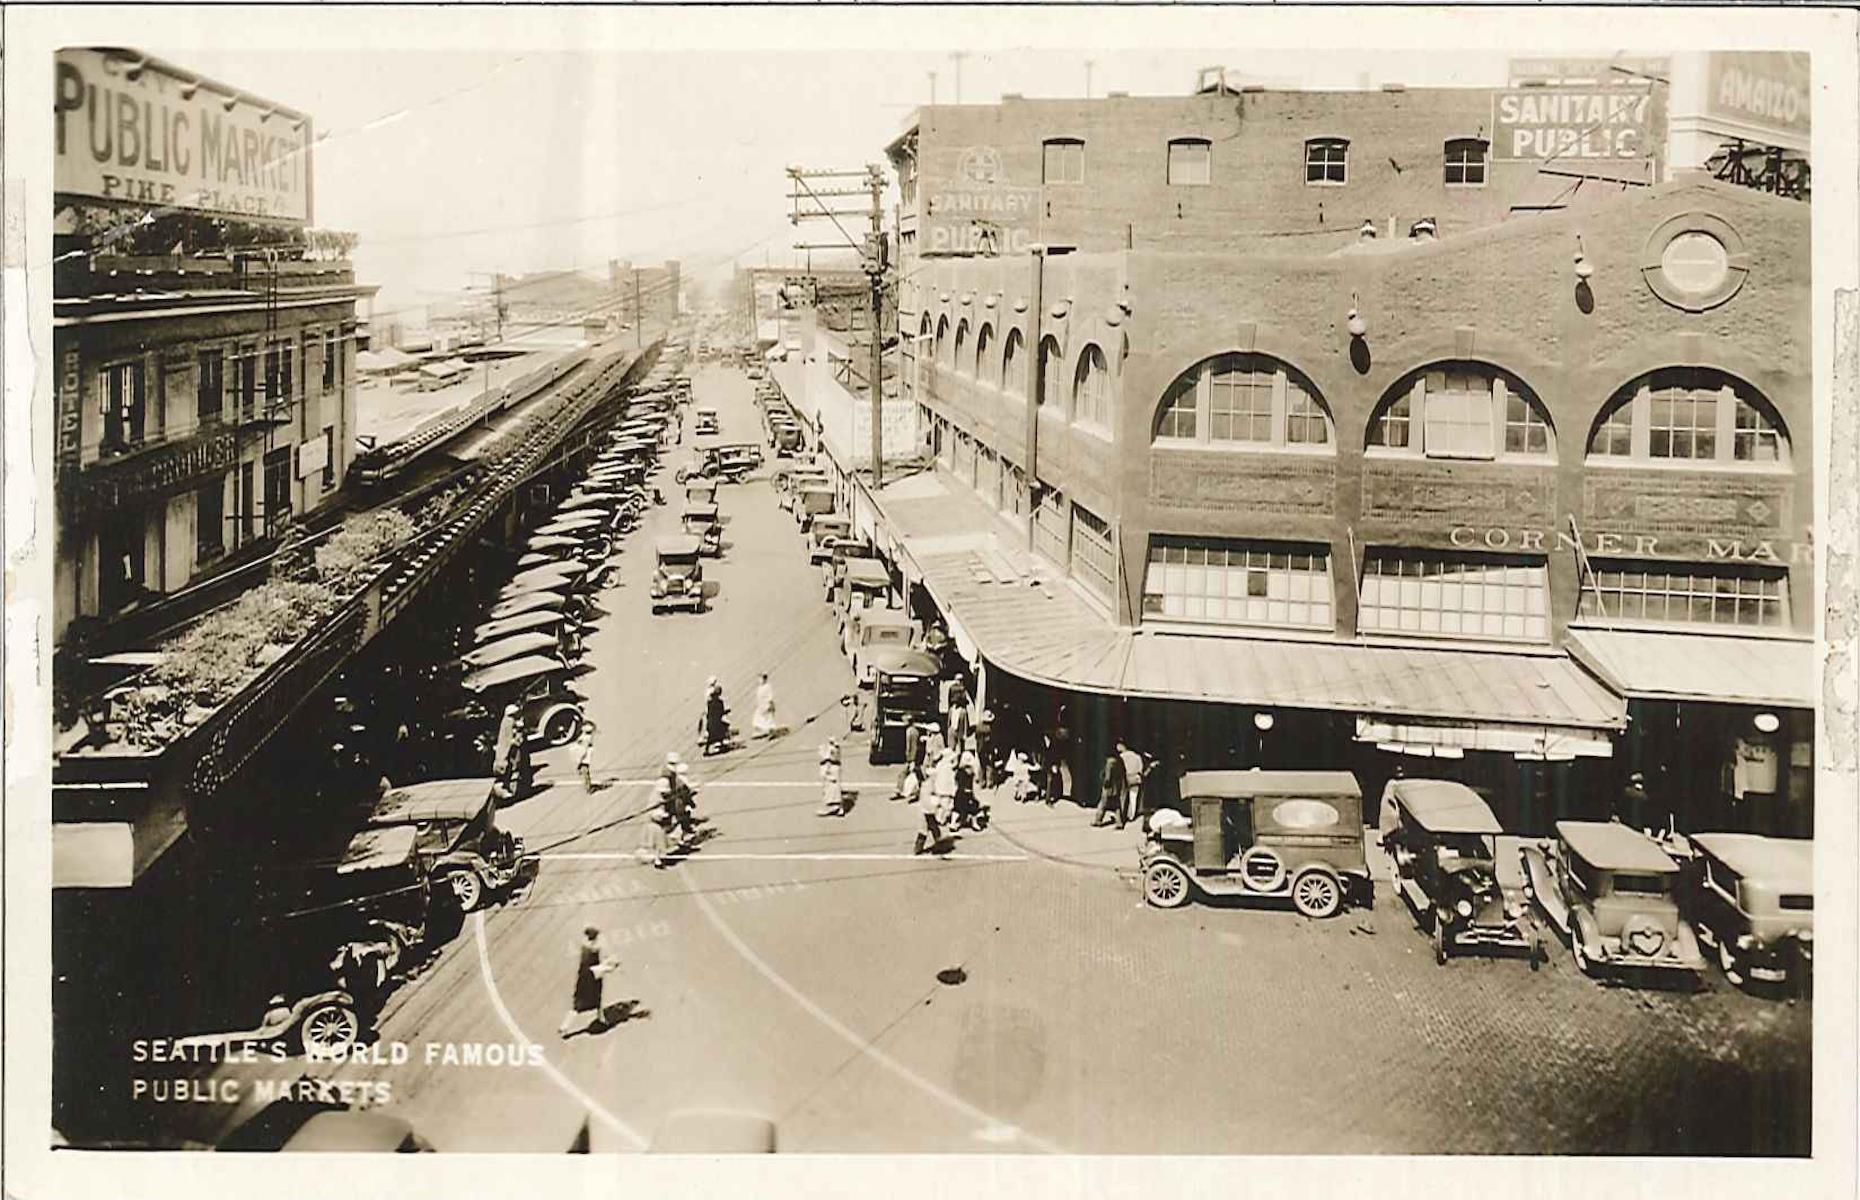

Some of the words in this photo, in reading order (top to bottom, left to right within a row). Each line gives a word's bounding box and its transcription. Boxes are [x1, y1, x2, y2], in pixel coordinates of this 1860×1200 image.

[1500, 94, 1651, 125] SANITARY
[53, 61, 190, 176] PUBLIC
[201, 110, 300, 194] MARKET
[1513, 127, 1638, 159] PUBLIC
[101, 174, 176, 204] PIKE
[196, 187, 268, 216] PLACE
[930, 194, 1033, 213] SANITARY
[62, 350, 80, 452] HOTEL
[1449, 527, 1659, 556] CORNER
